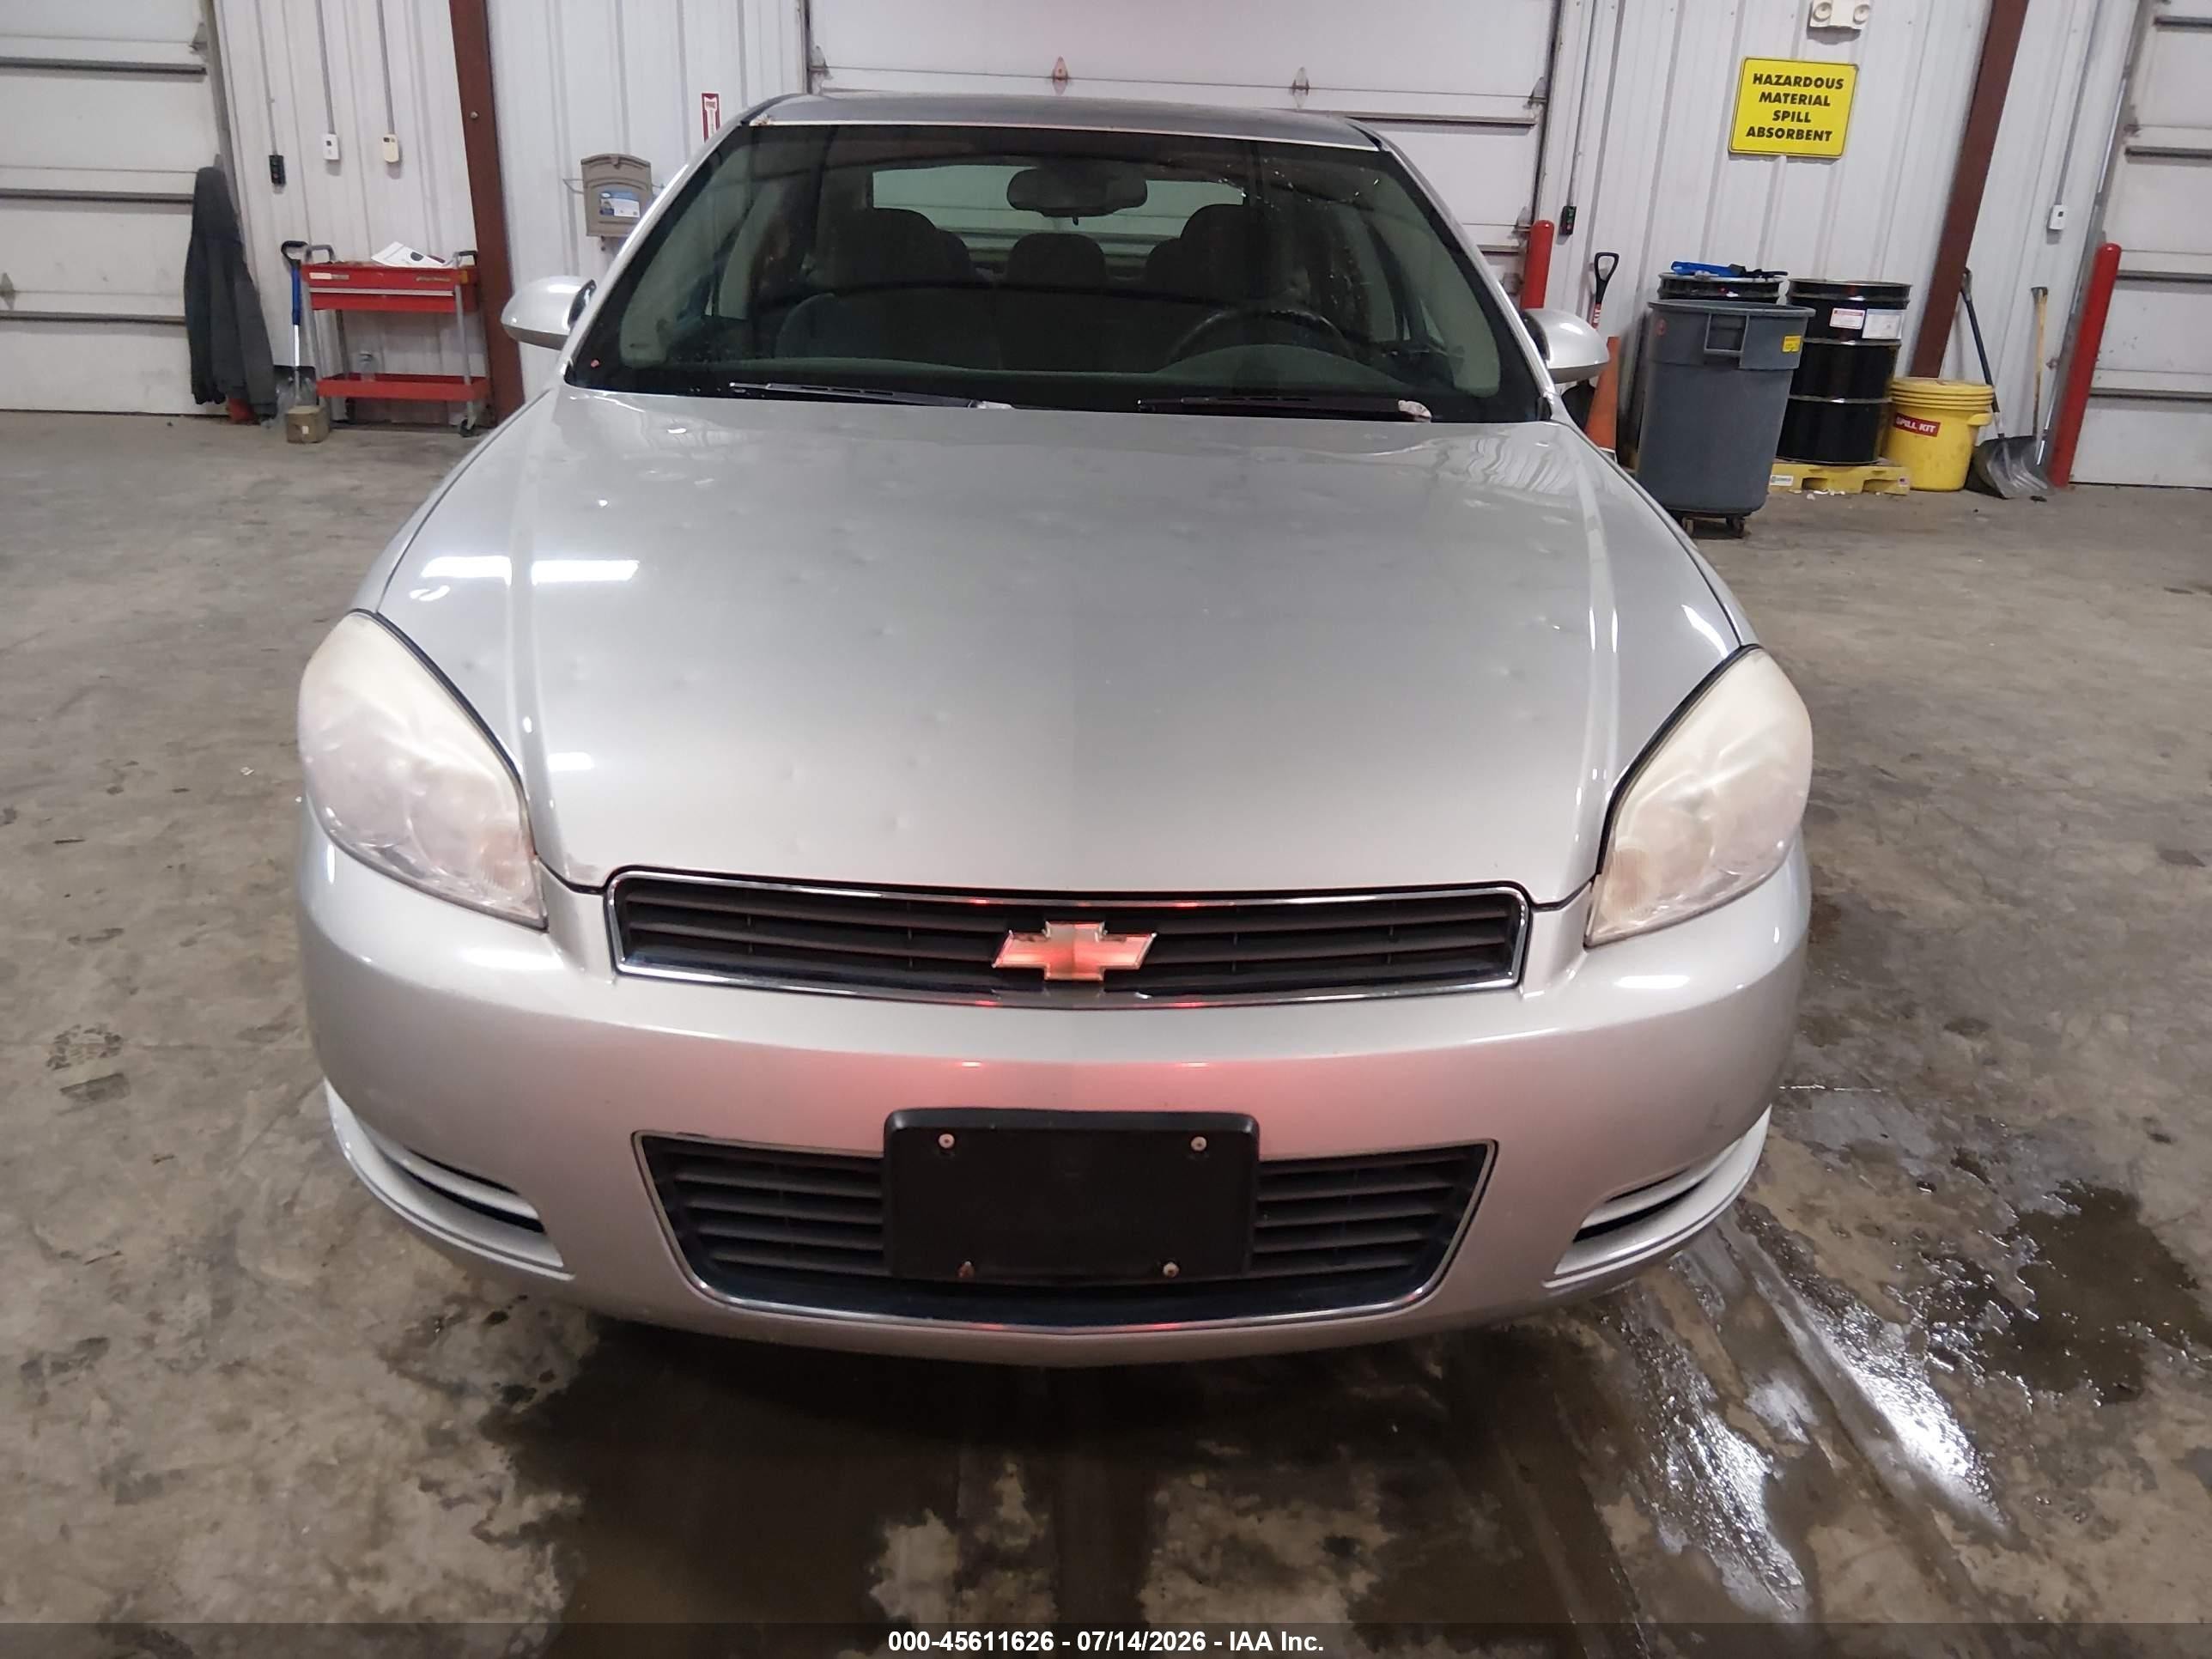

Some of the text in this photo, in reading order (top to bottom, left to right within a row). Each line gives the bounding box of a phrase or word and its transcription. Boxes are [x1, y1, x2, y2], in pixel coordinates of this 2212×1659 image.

[1753, 73, 1844, 89] HAZARDOUS
[1759, 92, 1831, 106] MATERIAL
[1772, 110, 1811, 123] SPILL
[1746, 126, 1832, 142] ABSORBENT
[1919, 423, 1936, 433] KIT
